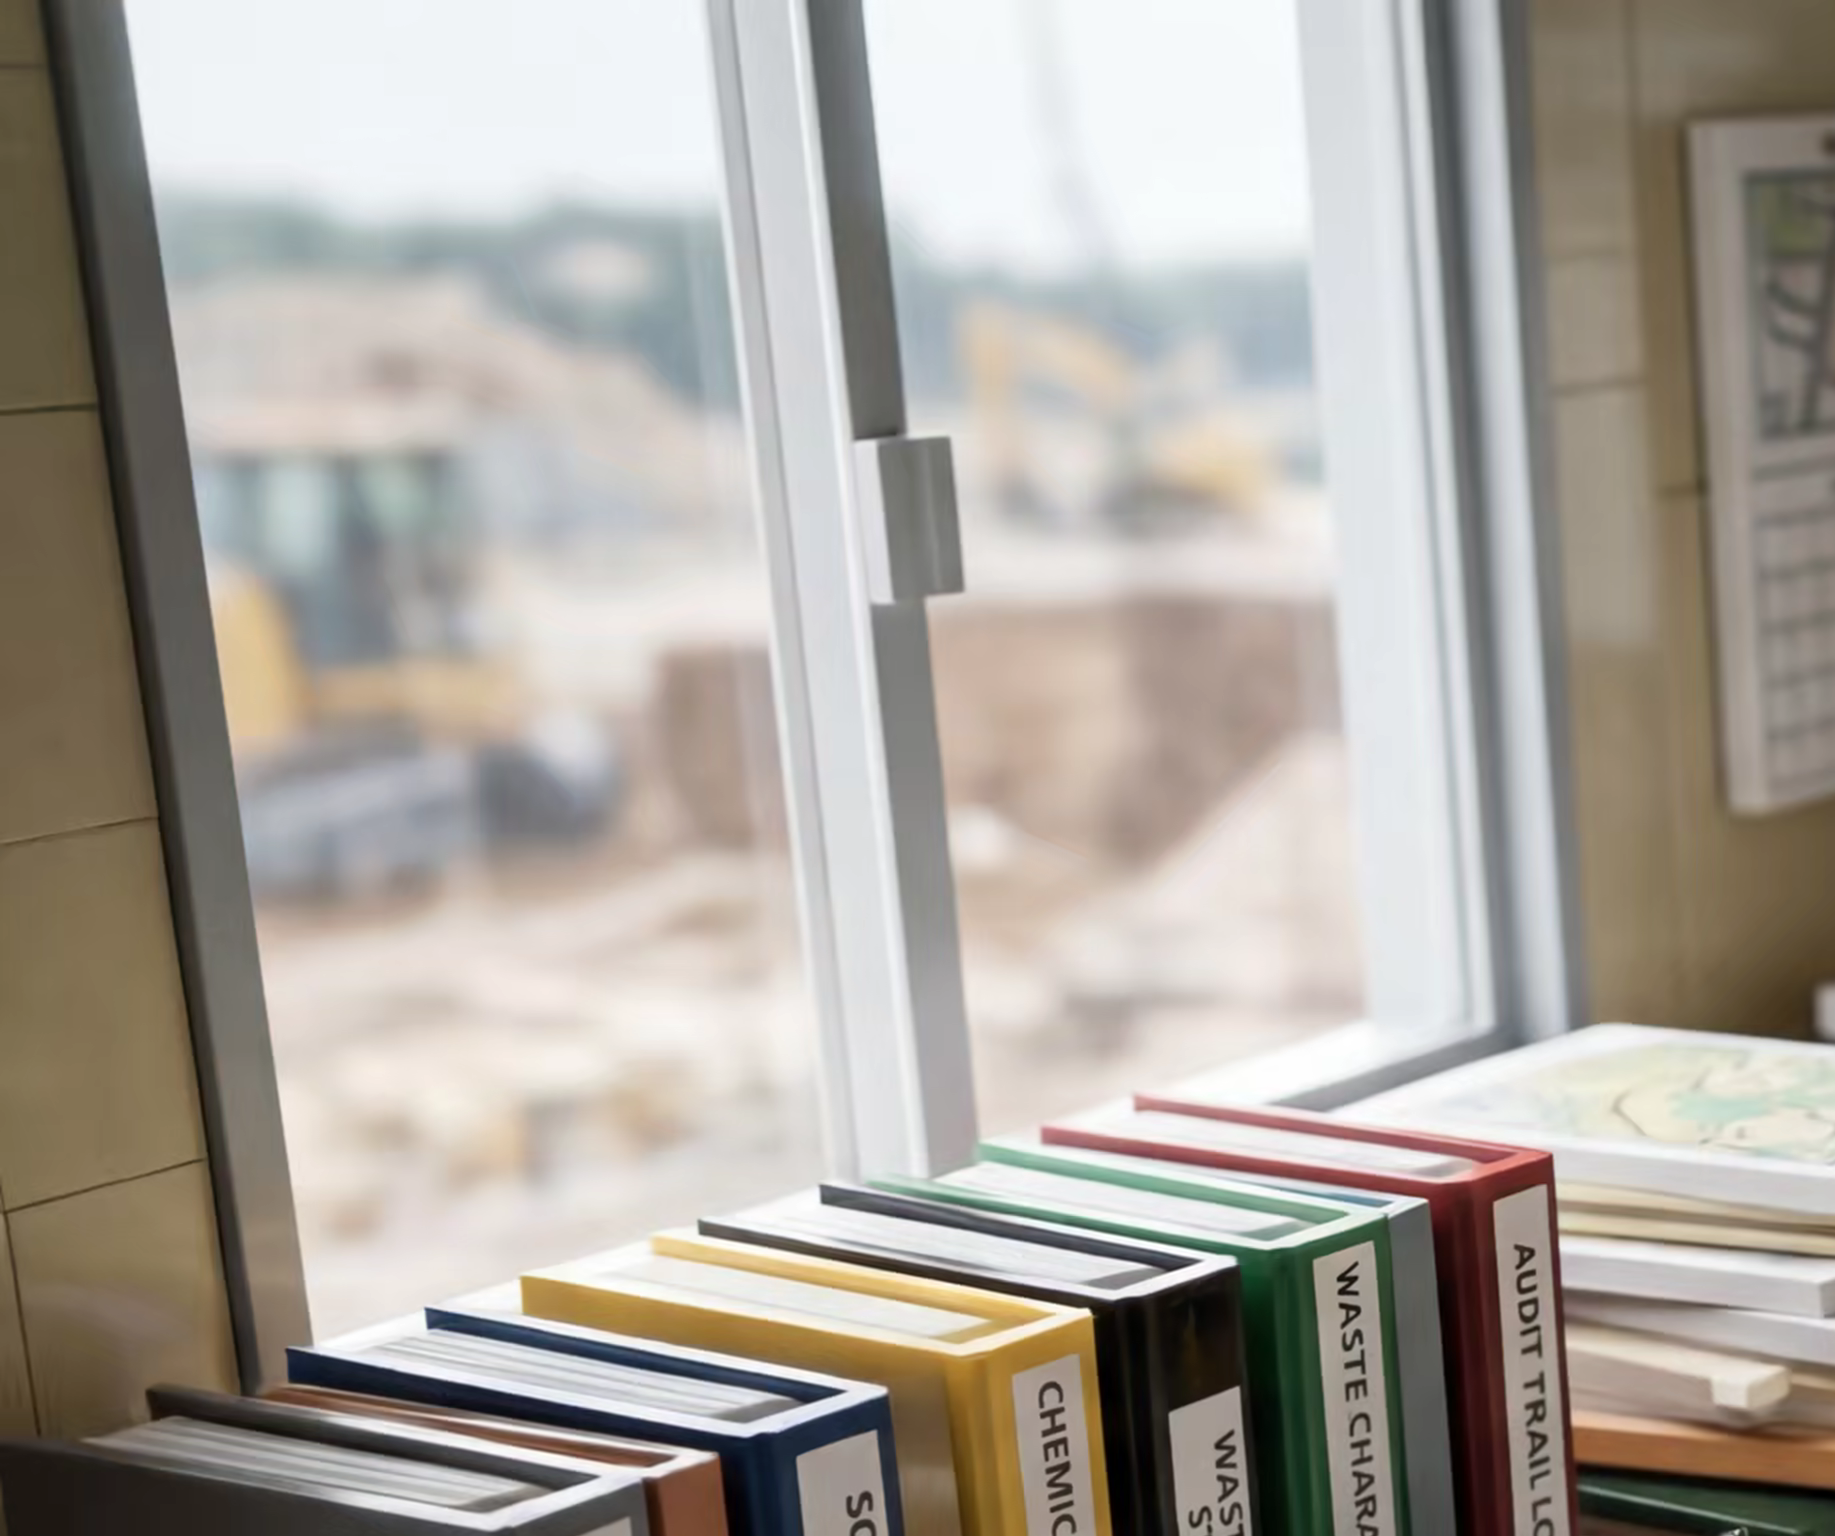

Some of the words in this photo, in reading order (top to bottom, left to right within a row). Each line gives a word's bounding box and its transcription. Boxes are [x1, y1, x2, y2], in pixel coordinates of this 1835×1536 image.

[1336, 1260, 1369, 1403] WASTE
[1513, 1243, 1544, 1360] AUDIT
[1522, 1370, 1552, 1491] TRAIL
